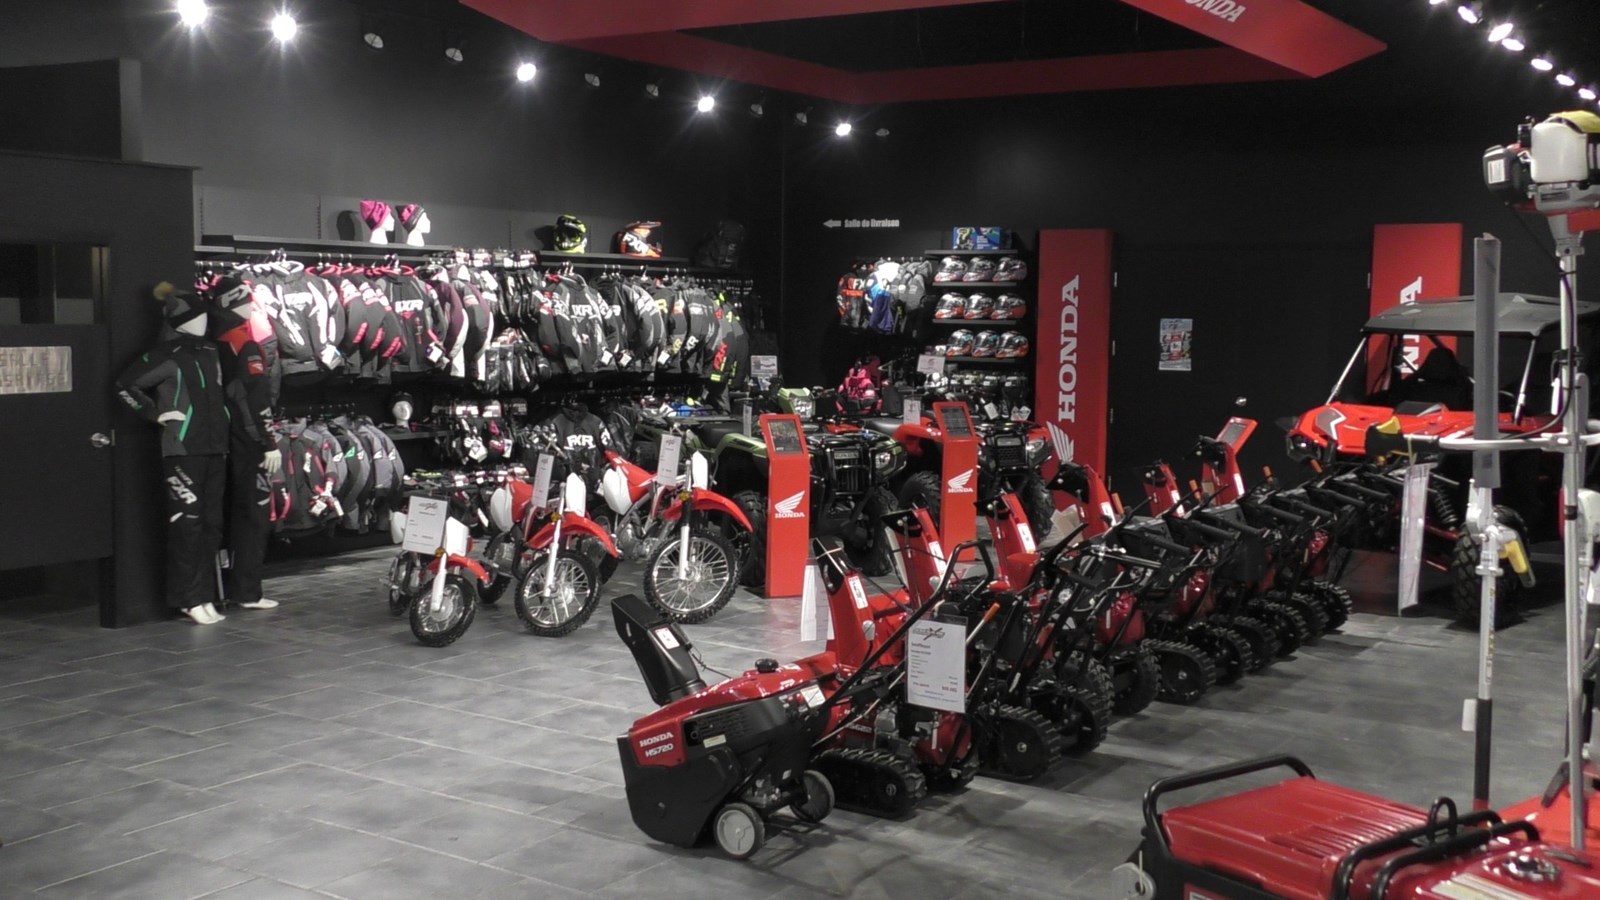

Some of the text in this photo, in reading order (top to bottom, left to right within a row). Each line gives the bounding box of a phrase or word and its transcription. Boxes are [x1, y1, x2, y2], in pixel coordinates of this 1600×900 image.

[844, 218, 900, 228] Salle de livraison
[623, 232, 651, 255] FXR
[1058, 274, 1080, 423] HONDA
[566, 434, 594, 449] FXR
[167, 476, 198, 504] FXR
[639, 731, 674, 749] HONDA
[645, 743, 674, 758] HS720
